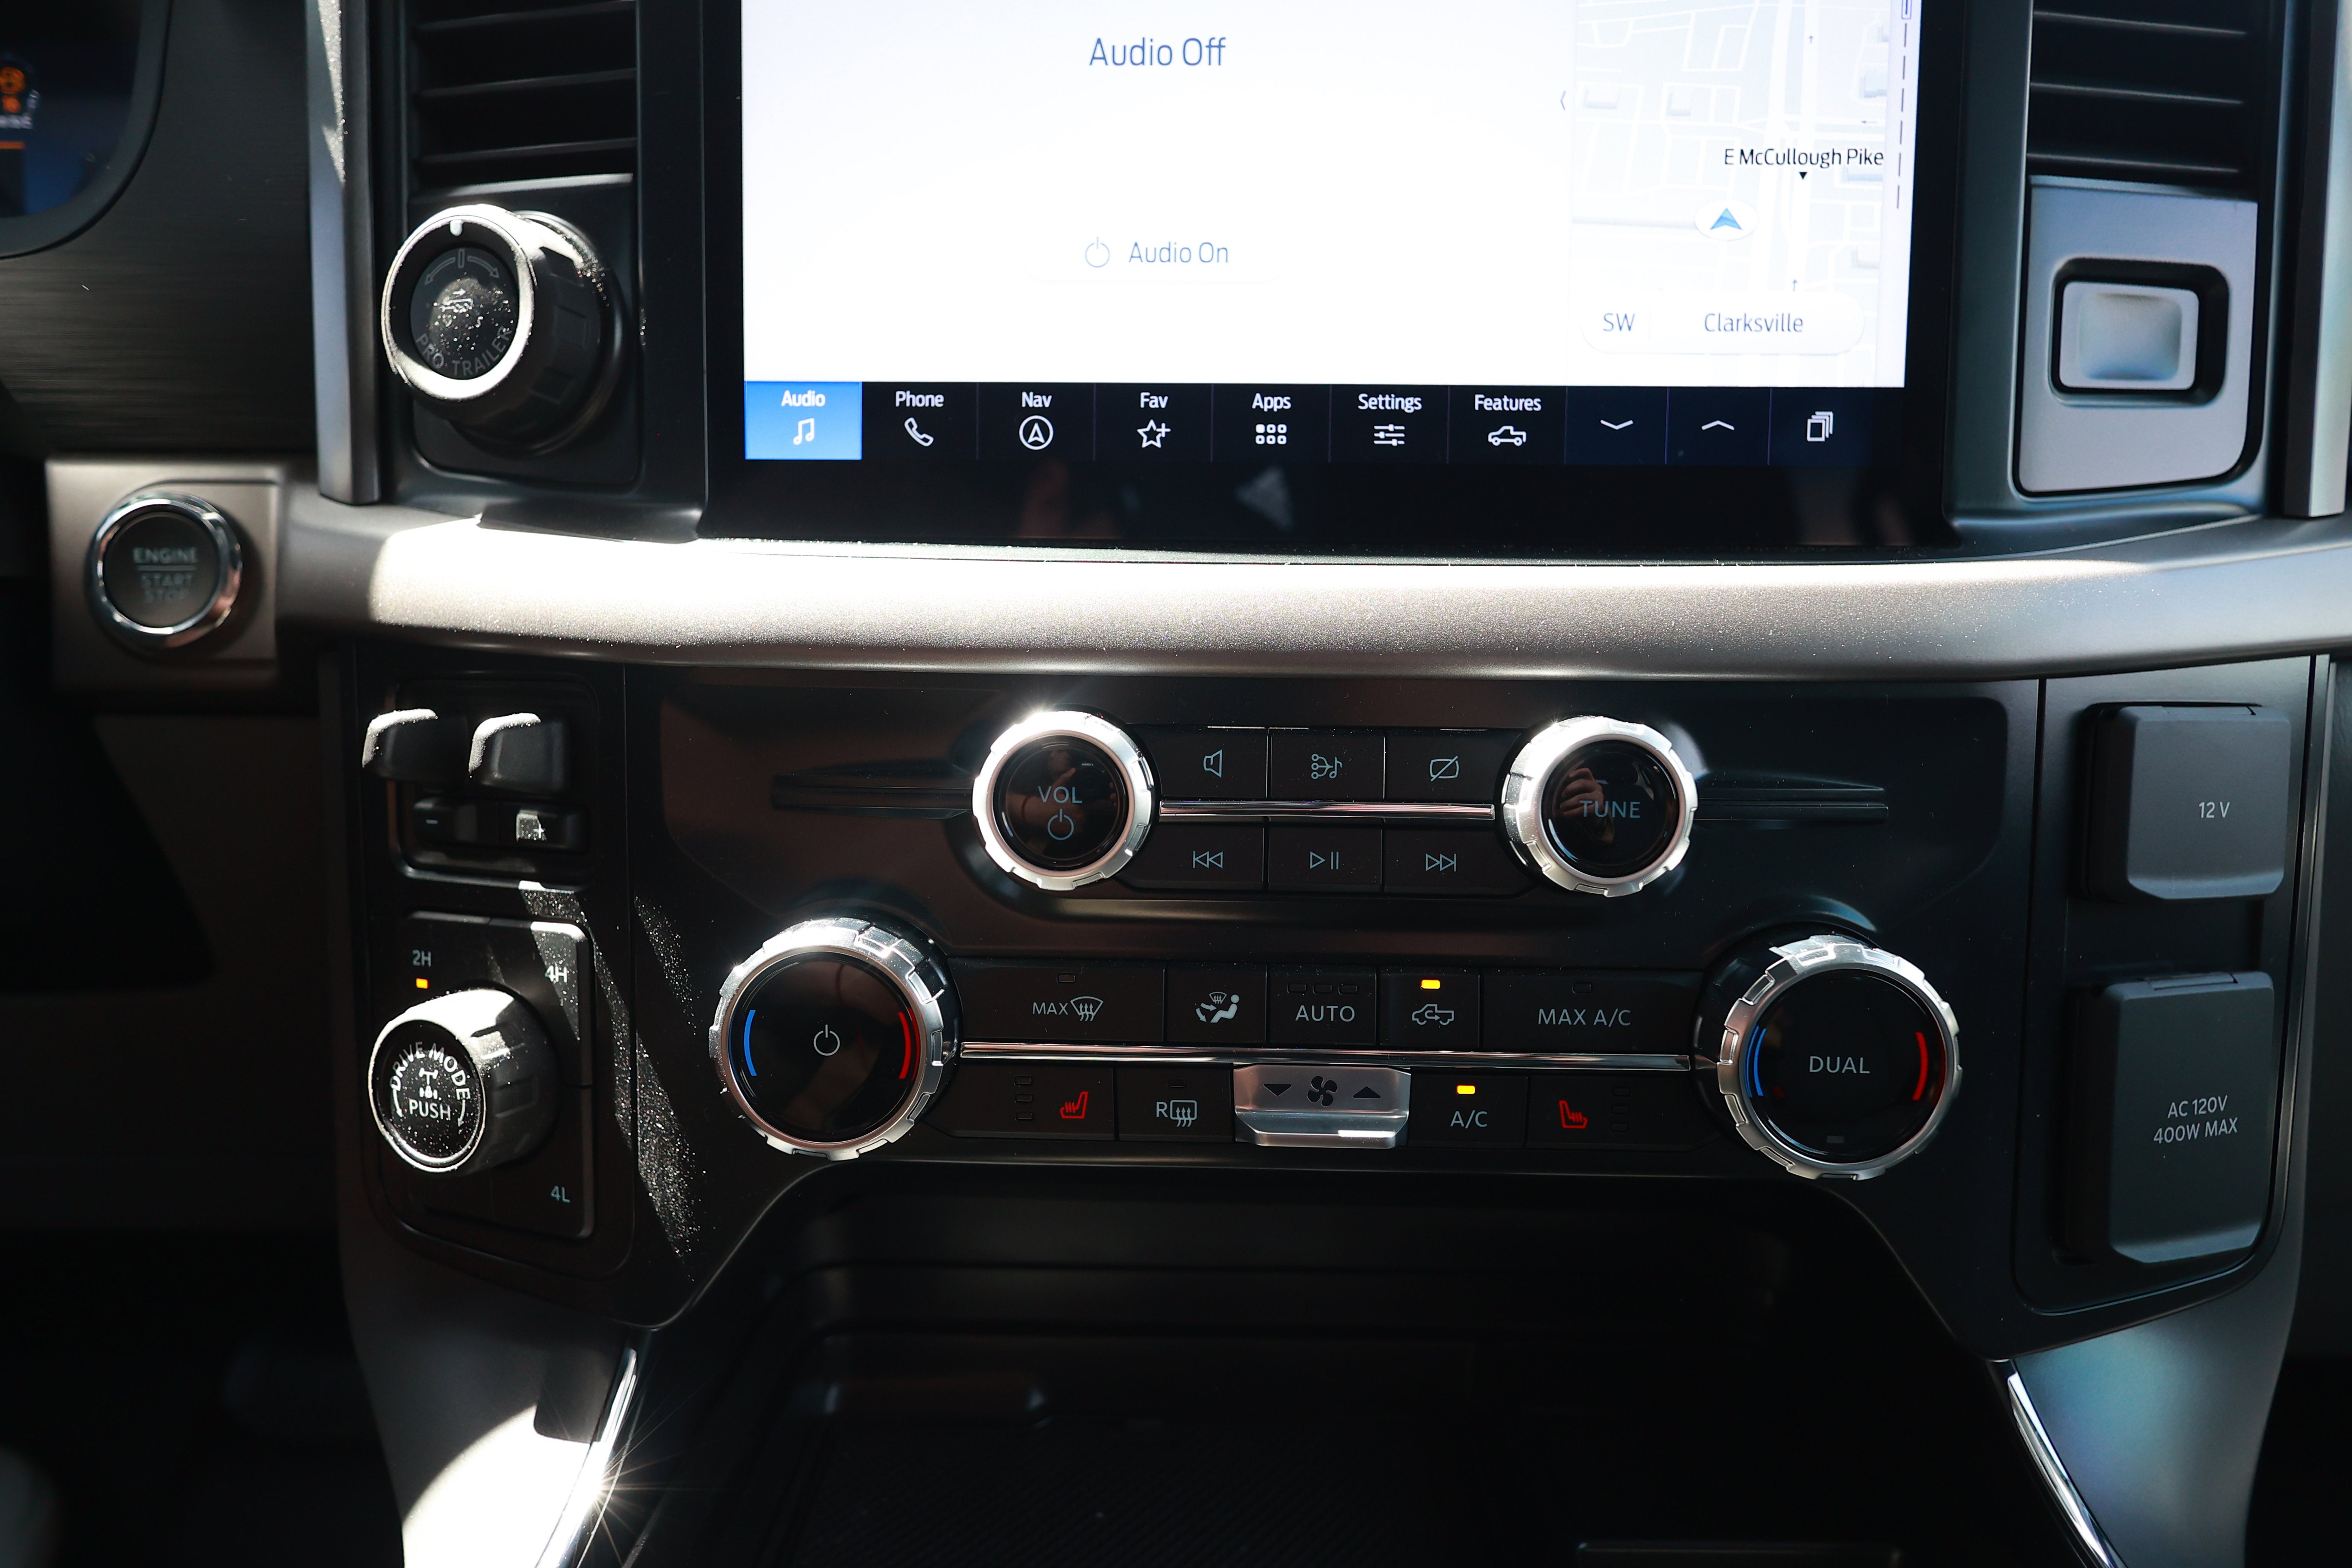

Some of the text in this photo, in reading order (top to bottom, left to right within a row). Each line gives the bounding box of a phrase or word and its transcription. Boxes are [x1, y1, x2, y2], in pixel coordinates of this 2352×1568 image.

[1089, 37, 1226, 66] Audio Off
[1724, 148, 1883, 168] E McCullough Pike
[1129, 241, 1228, 263] Audio On
[1603, 313, 1635, 331] SW
[1705, 313, 1803, 332] Clarksville
[415, 325, 512, 376] PRO TRAILER
[781, 390, 826, 407] Audio
[895, 390, 944, 407] Phone
[1022, 391, 1052, 408] Nav
[1140, 392, 1168, 408] Fav
[1252, 392, 1291, 412] Apps
[1358, 393, 1422, 413] Settings
[1474, 394, 1541, 411] Features
[133, 547, 198, 564] ENGINE
[1038, 786, 1082, 803] VOL
[1579, 800, 1640, 818] TUNE
[2199, 801, 2230, 818] 12 V
[413, 949, 431, 967] 2H
[545, 965, 567, 983] 4H
[1032, 1002, 1069, 1015] MAX
[1295, 1005, 1355, 1022] AUTO
[1538, 1008, 1631, 1027] MAX A/C
[390, 1041, 471, 1100] DRIVE MODE
[1809, 1056, 1870, 1074] DUAL
[409, 1099, 451, 1121] PUSH
[2167, 1095, 2228, 1118] AC 120V
[1450, 1110, 1488, 1129] A/C
[2153, 1117, 2238, 1144] 400W MAX
[551, 1185, 570, 1203] 4L
